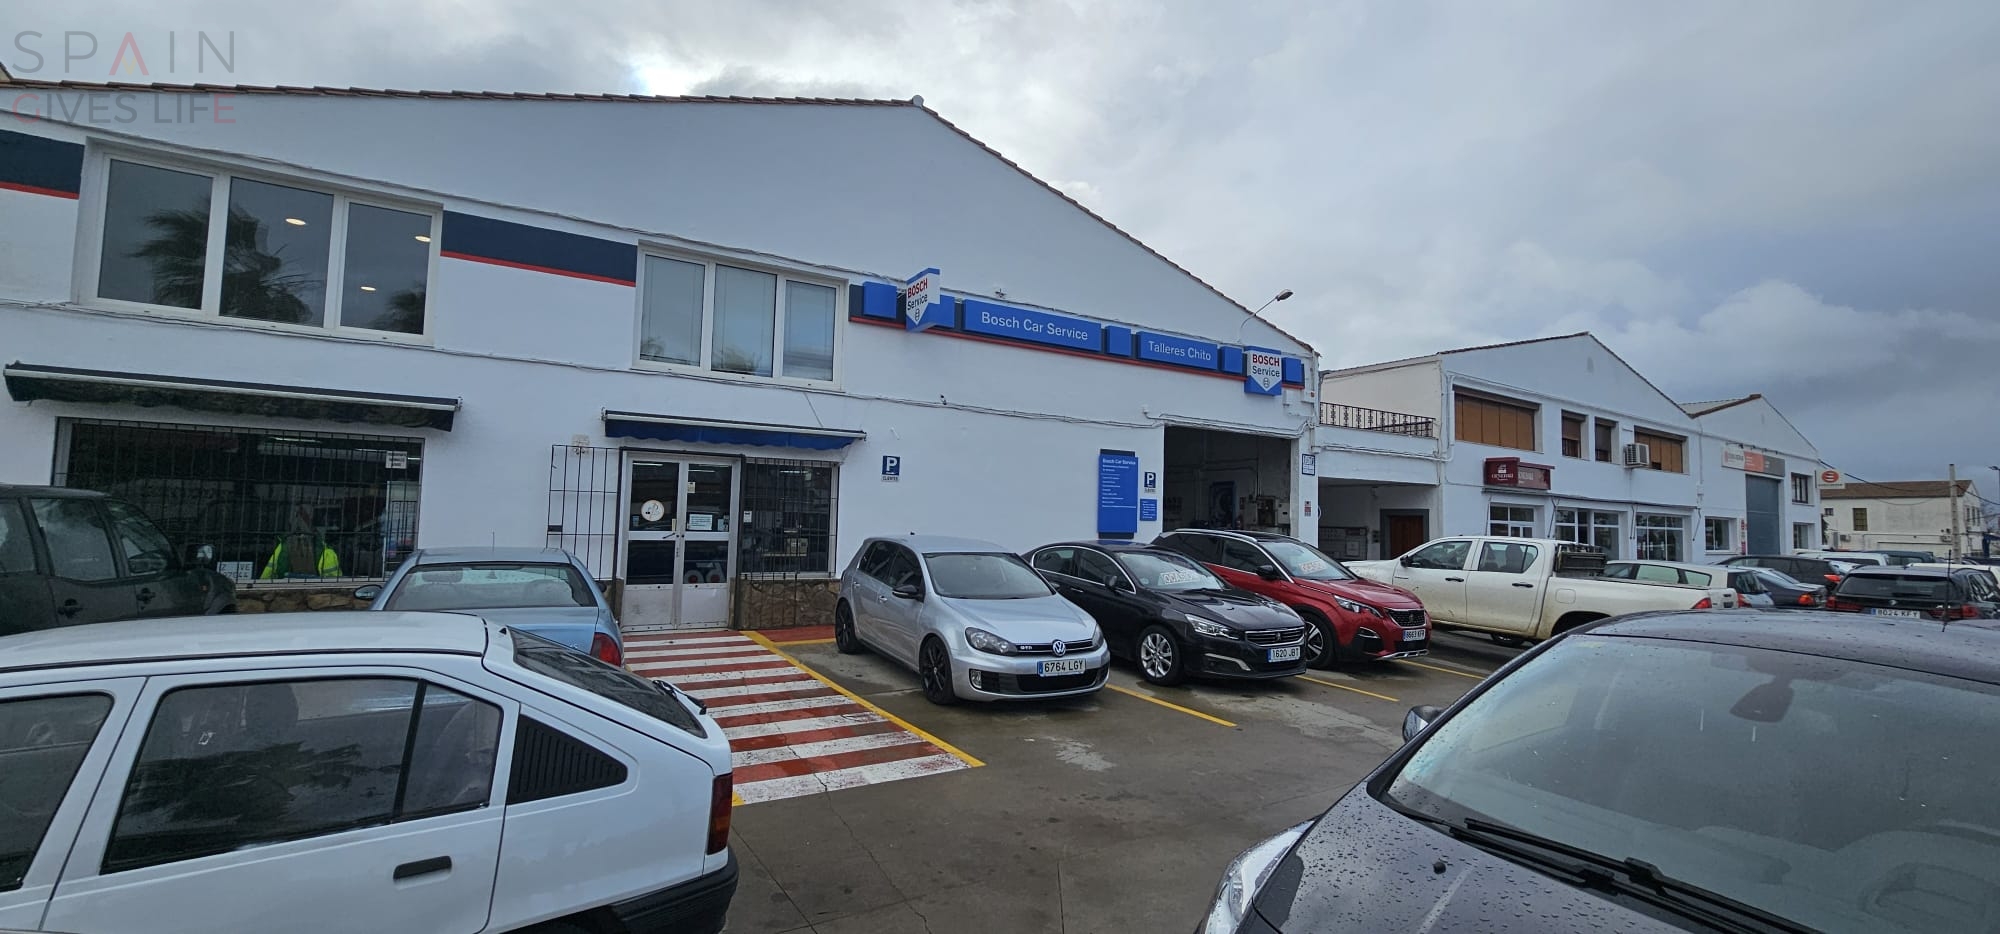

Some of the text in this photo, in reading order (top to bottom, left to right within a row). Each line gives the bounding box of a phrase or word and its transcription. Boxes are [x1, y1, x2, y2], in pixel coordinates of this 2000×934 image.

[907, 277, 928, 298] BOSCH
[907, 294, 928, 311] Service
[981, 311, 1088, 341] Bosch Car Service
[1149, 341, 1211, 361] Talleres Chito
[1252, 354, 1280, 367] BOSCH
[1252, 365, 1280, 378] Service
[886, 457, 898, 472] P
[1146, 473, 1155, 485] P
[1272, 650, 1287, 658] 1620
[1044, 660, 1084, 673] 6764 LGY
